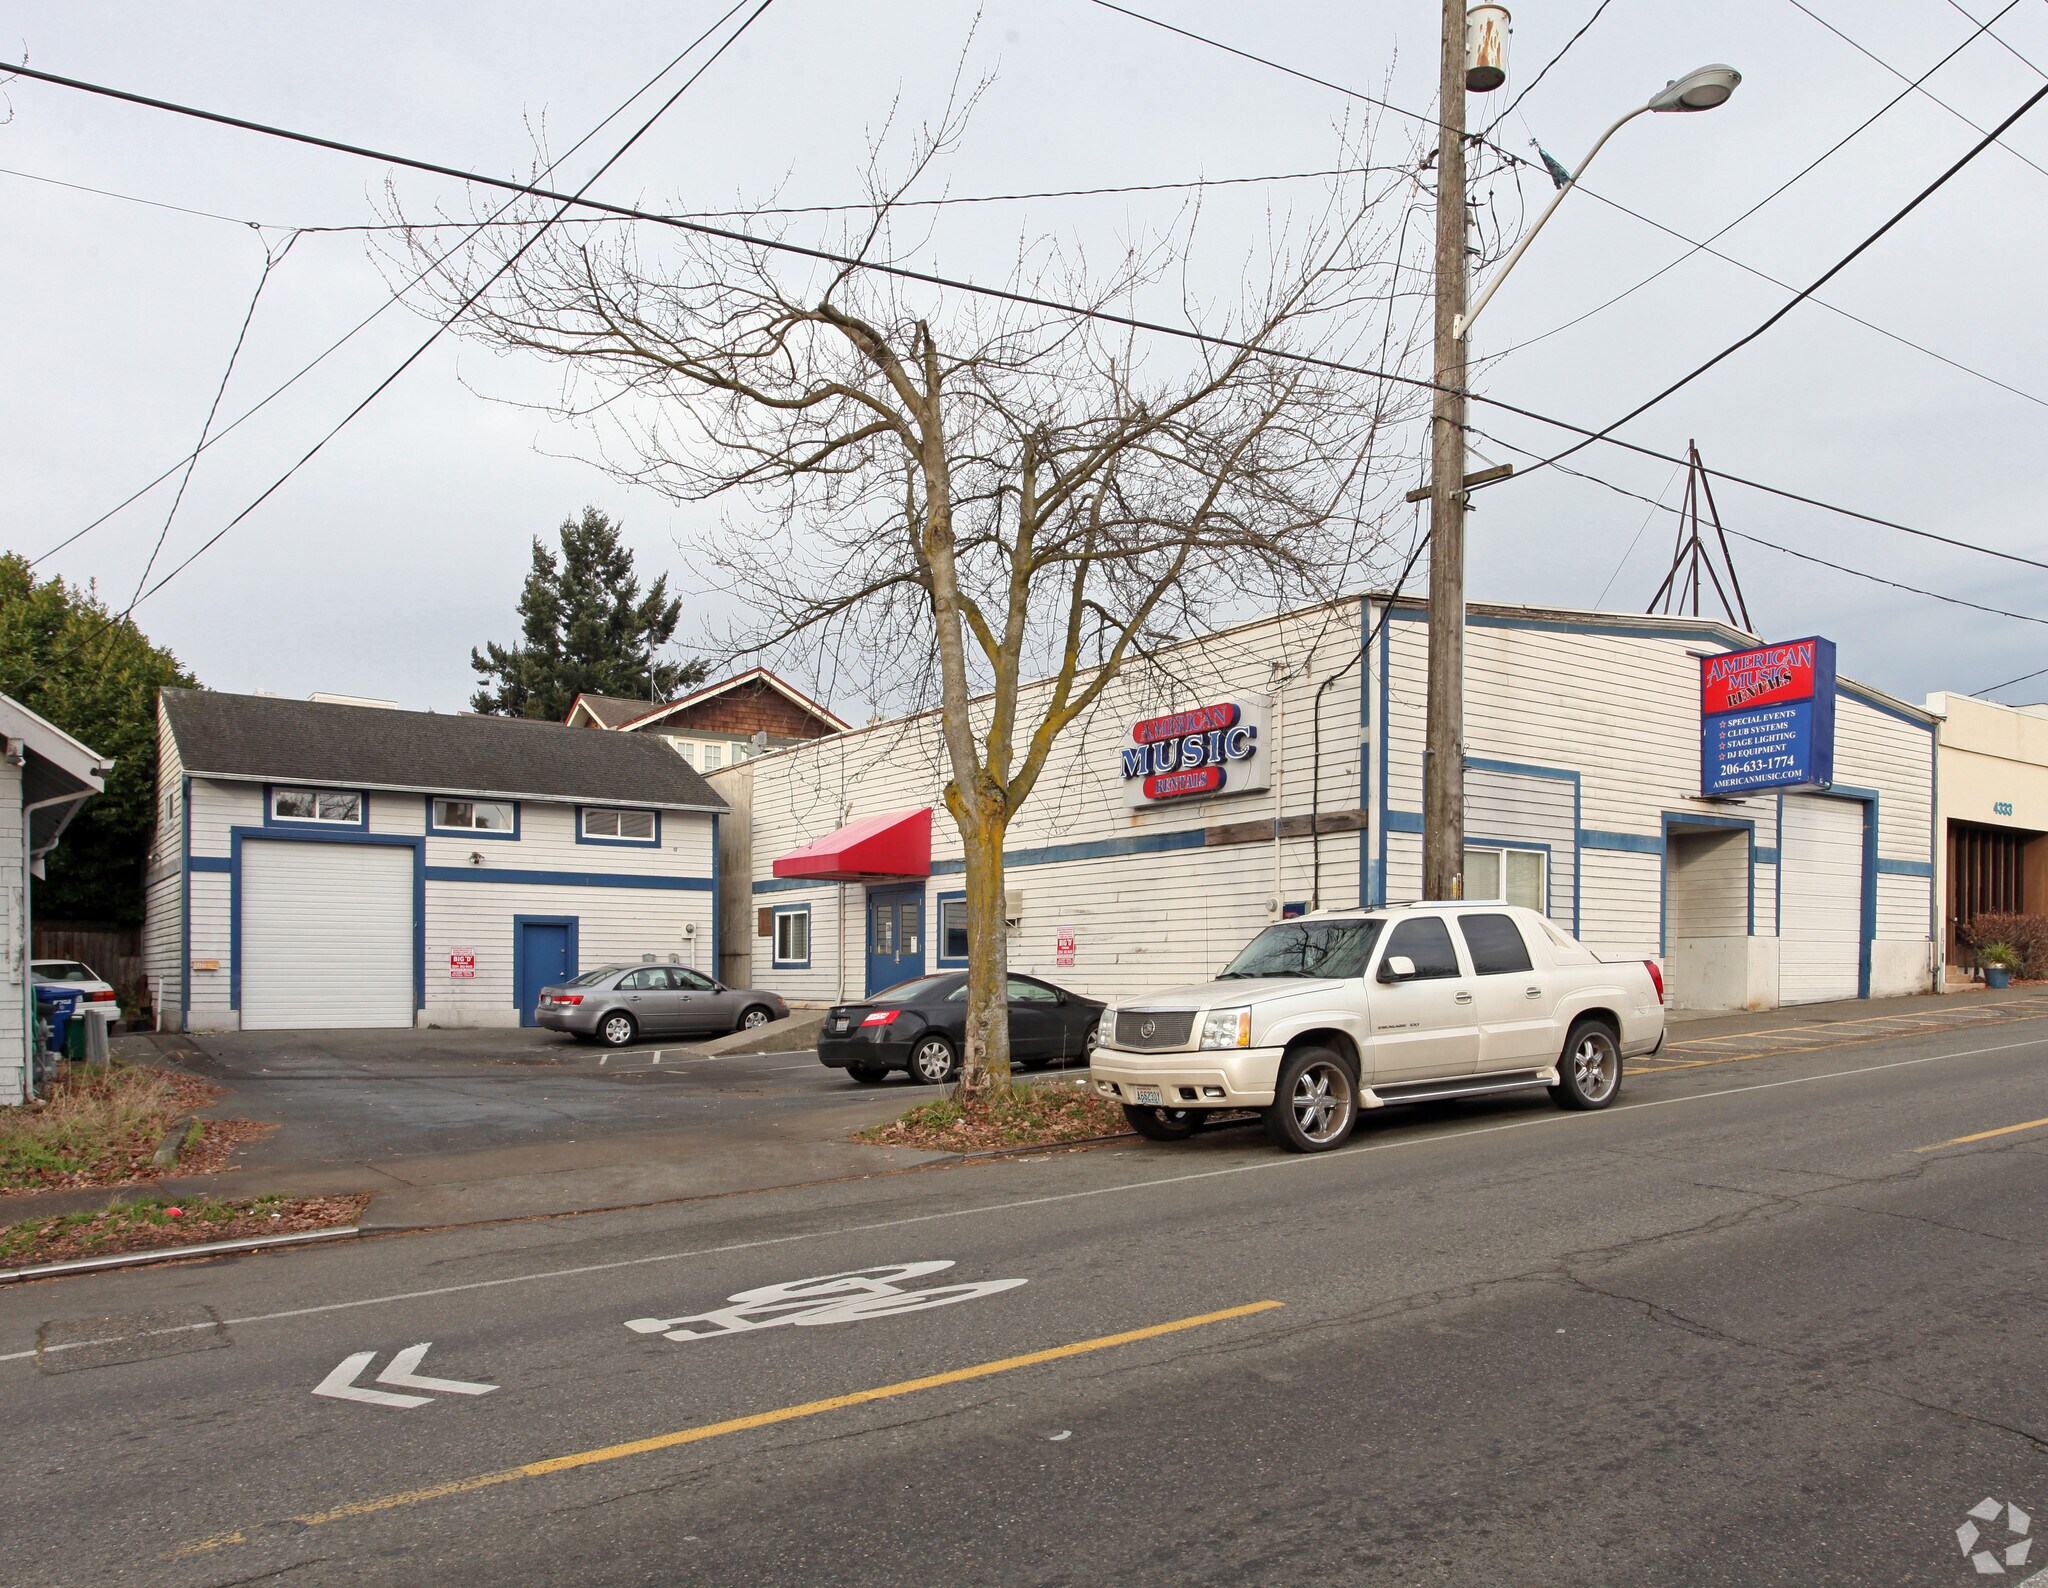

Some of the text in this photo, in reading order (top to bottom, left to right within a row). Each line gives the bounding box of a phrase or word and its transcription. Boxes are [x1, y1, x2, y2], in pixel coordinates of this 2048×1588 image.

[1706, 643, 1813, 688] AMERICAN
[1726, 671, 1792, 708] RENTALS
[1727, 665, 1790, 691] MUSIC
[1139, 706, 1228, 742] AMERICAN
[1727, 709, 1796, 727] SPECIAL EVENTS
[1727, 721, 1789, 738] CLUB SYSTEMS
[1727, 731, 1796, 749] STAGE LIGHTING
[1727, 743, 1787, 760] DJ EQUIPMENT
[1119, 725, 1252, 779] MUSIC
[1720, 754, 1795, 777] 206-633-1774
[1155, 771, 1208, 795] RENTALS
[1713, 769, 1802, 788] AMERICANMUSIC.COM
[1993, 801, 2013, 817] 4333
